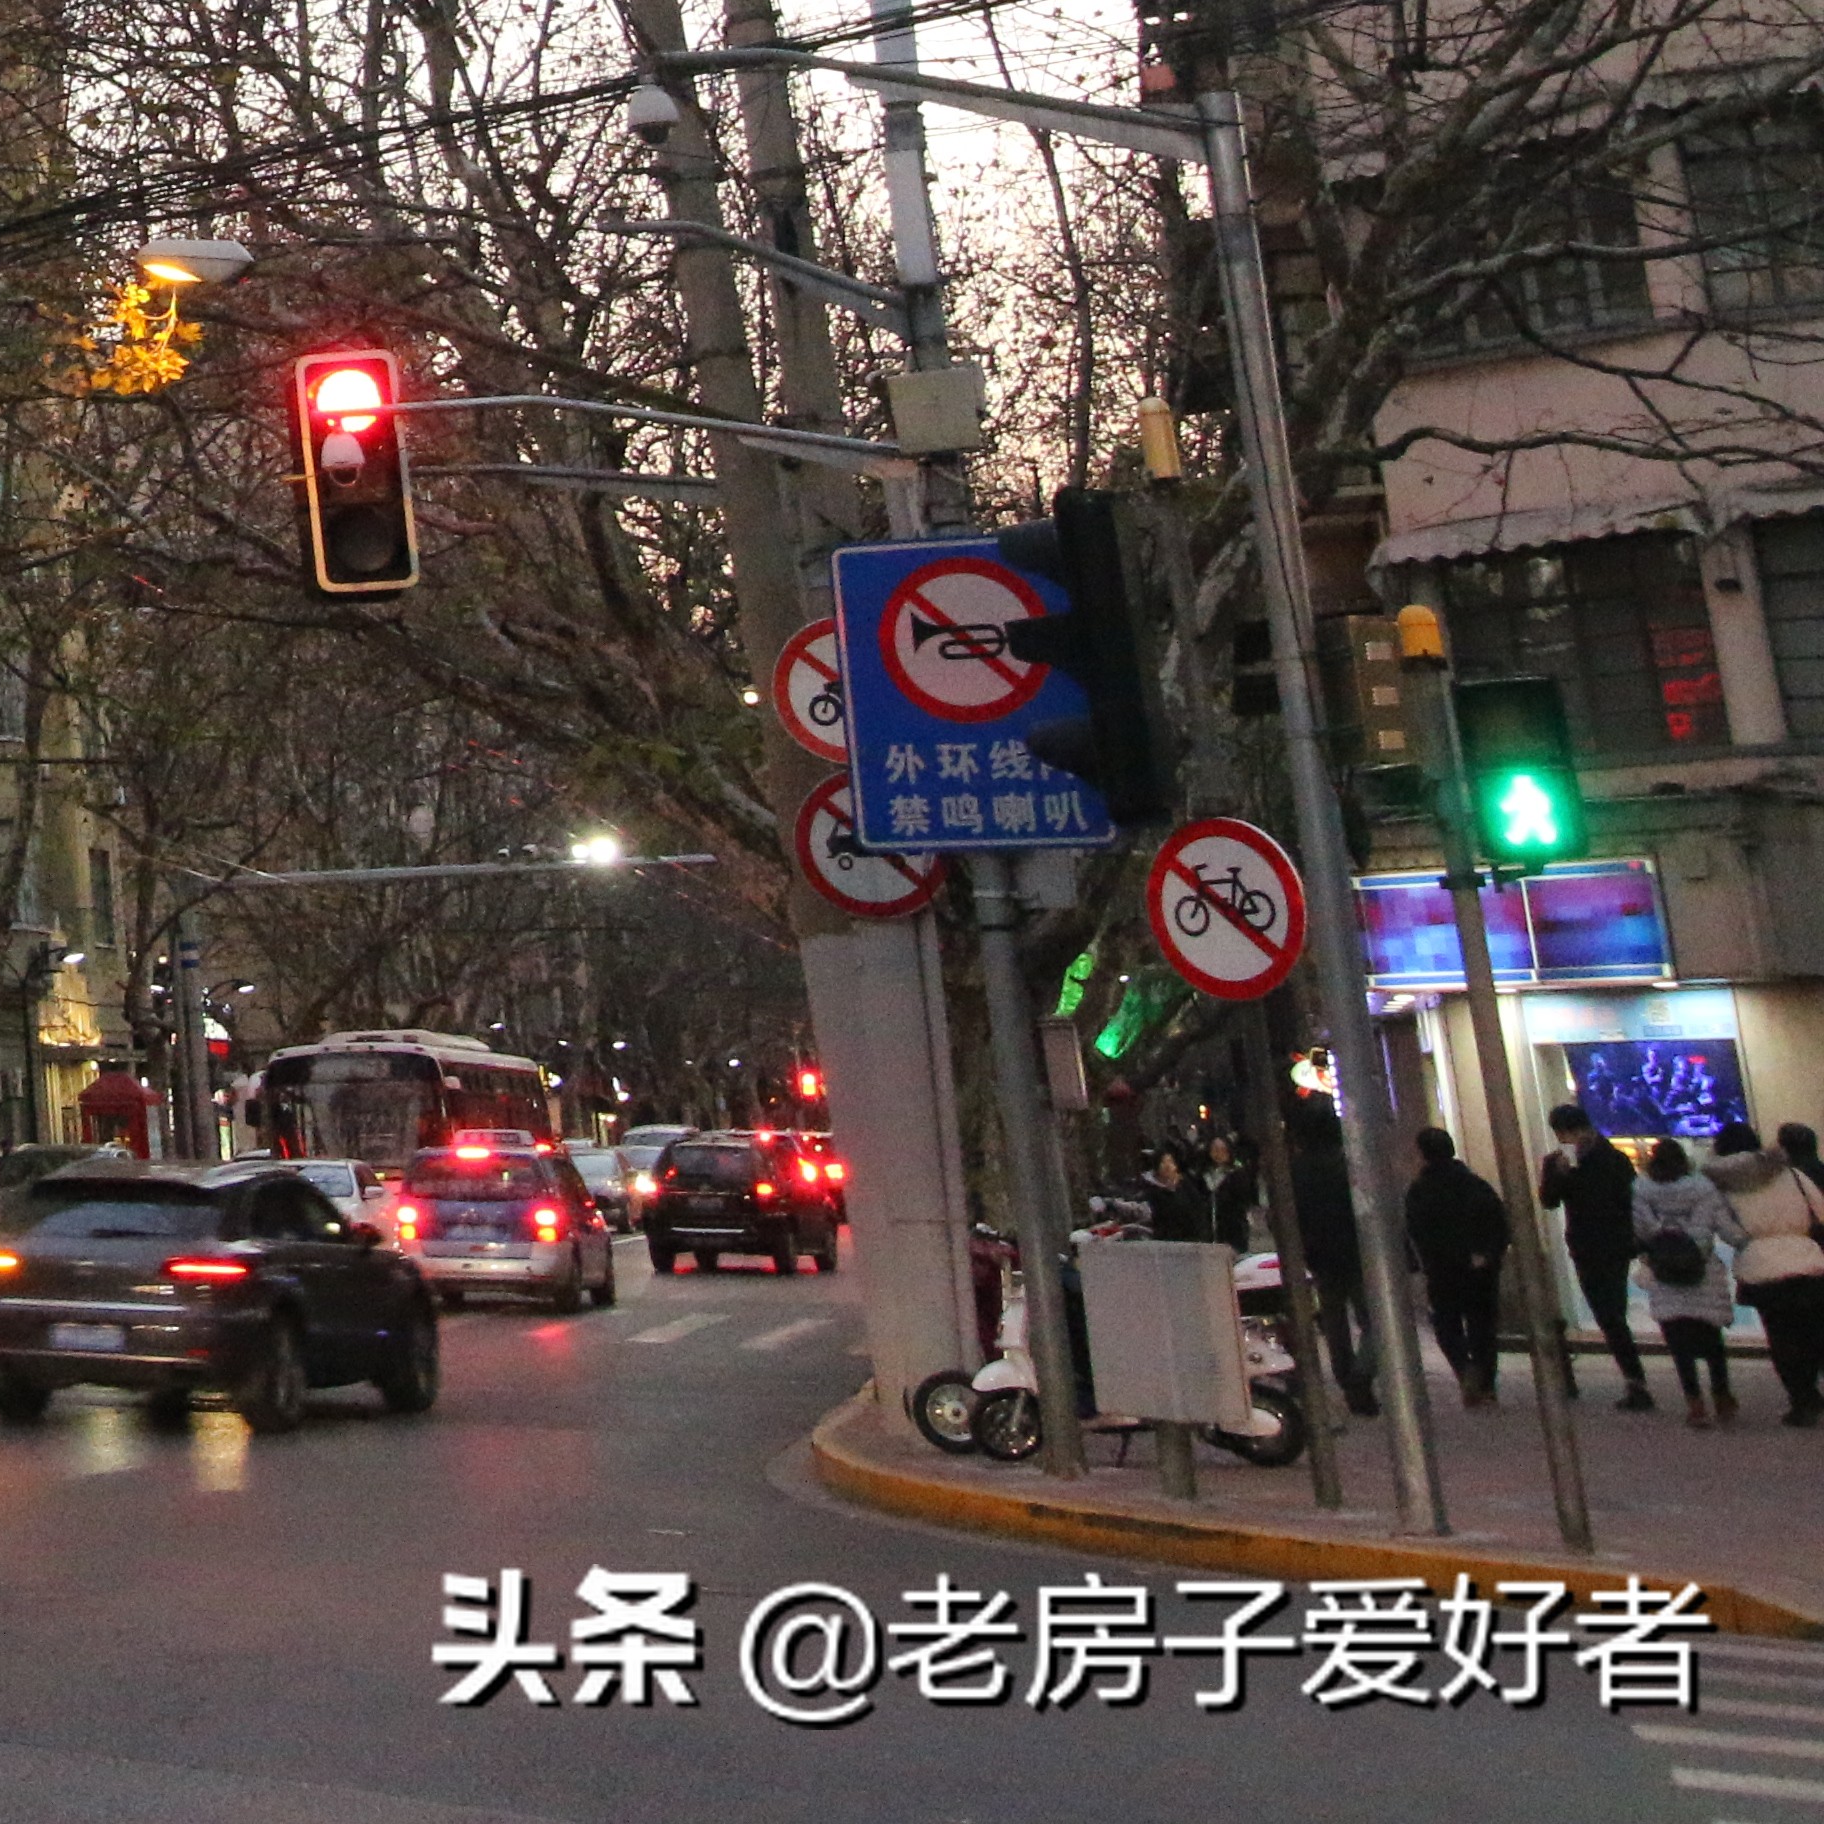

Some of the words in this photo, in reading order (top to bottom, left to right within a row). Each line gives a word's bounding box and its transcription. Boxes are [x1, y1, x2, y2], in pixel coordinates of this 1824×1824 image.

[885, 738, 1075, 784] 外环线
[889, 790, 1088, 836] 禁鸣喇叭
